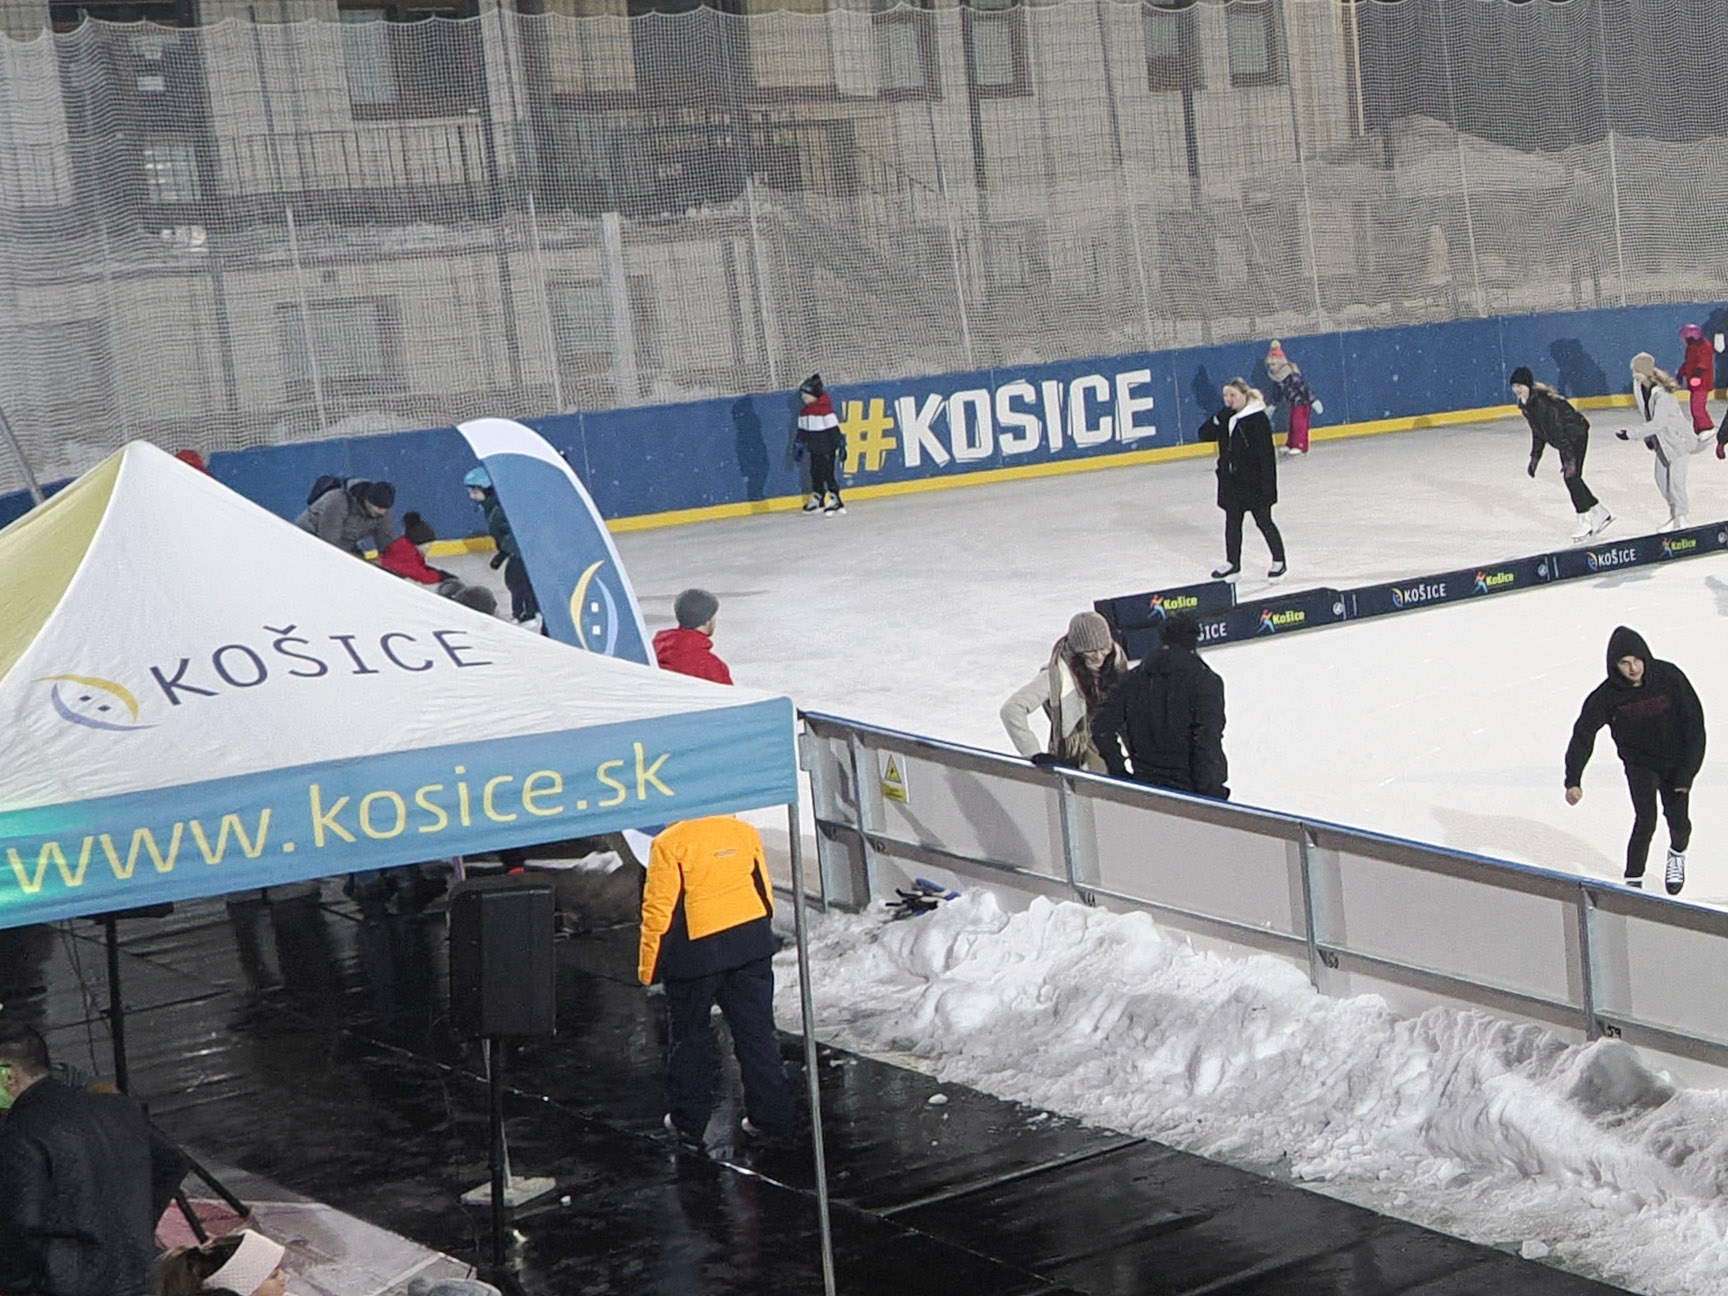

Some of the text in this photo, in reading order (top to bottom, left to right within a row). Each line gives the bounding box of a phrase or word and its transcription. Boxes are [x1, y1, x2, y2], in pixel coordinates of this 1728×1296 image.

[838, 369, 1156, 478] #KOSICE
[1599, 548, 1636, 567] KOŠICE
[1163, 595, 1198, 610] Košice
[1404, 583, 1446, 603] KOŠICE
[1272, 610, 1305, 624] Košice
[1197, 622, 1227, 641] ŠICE
[150, 624, 494, 706] KOŠICE
[4, 741, 676, 895] www.kosice.sk
